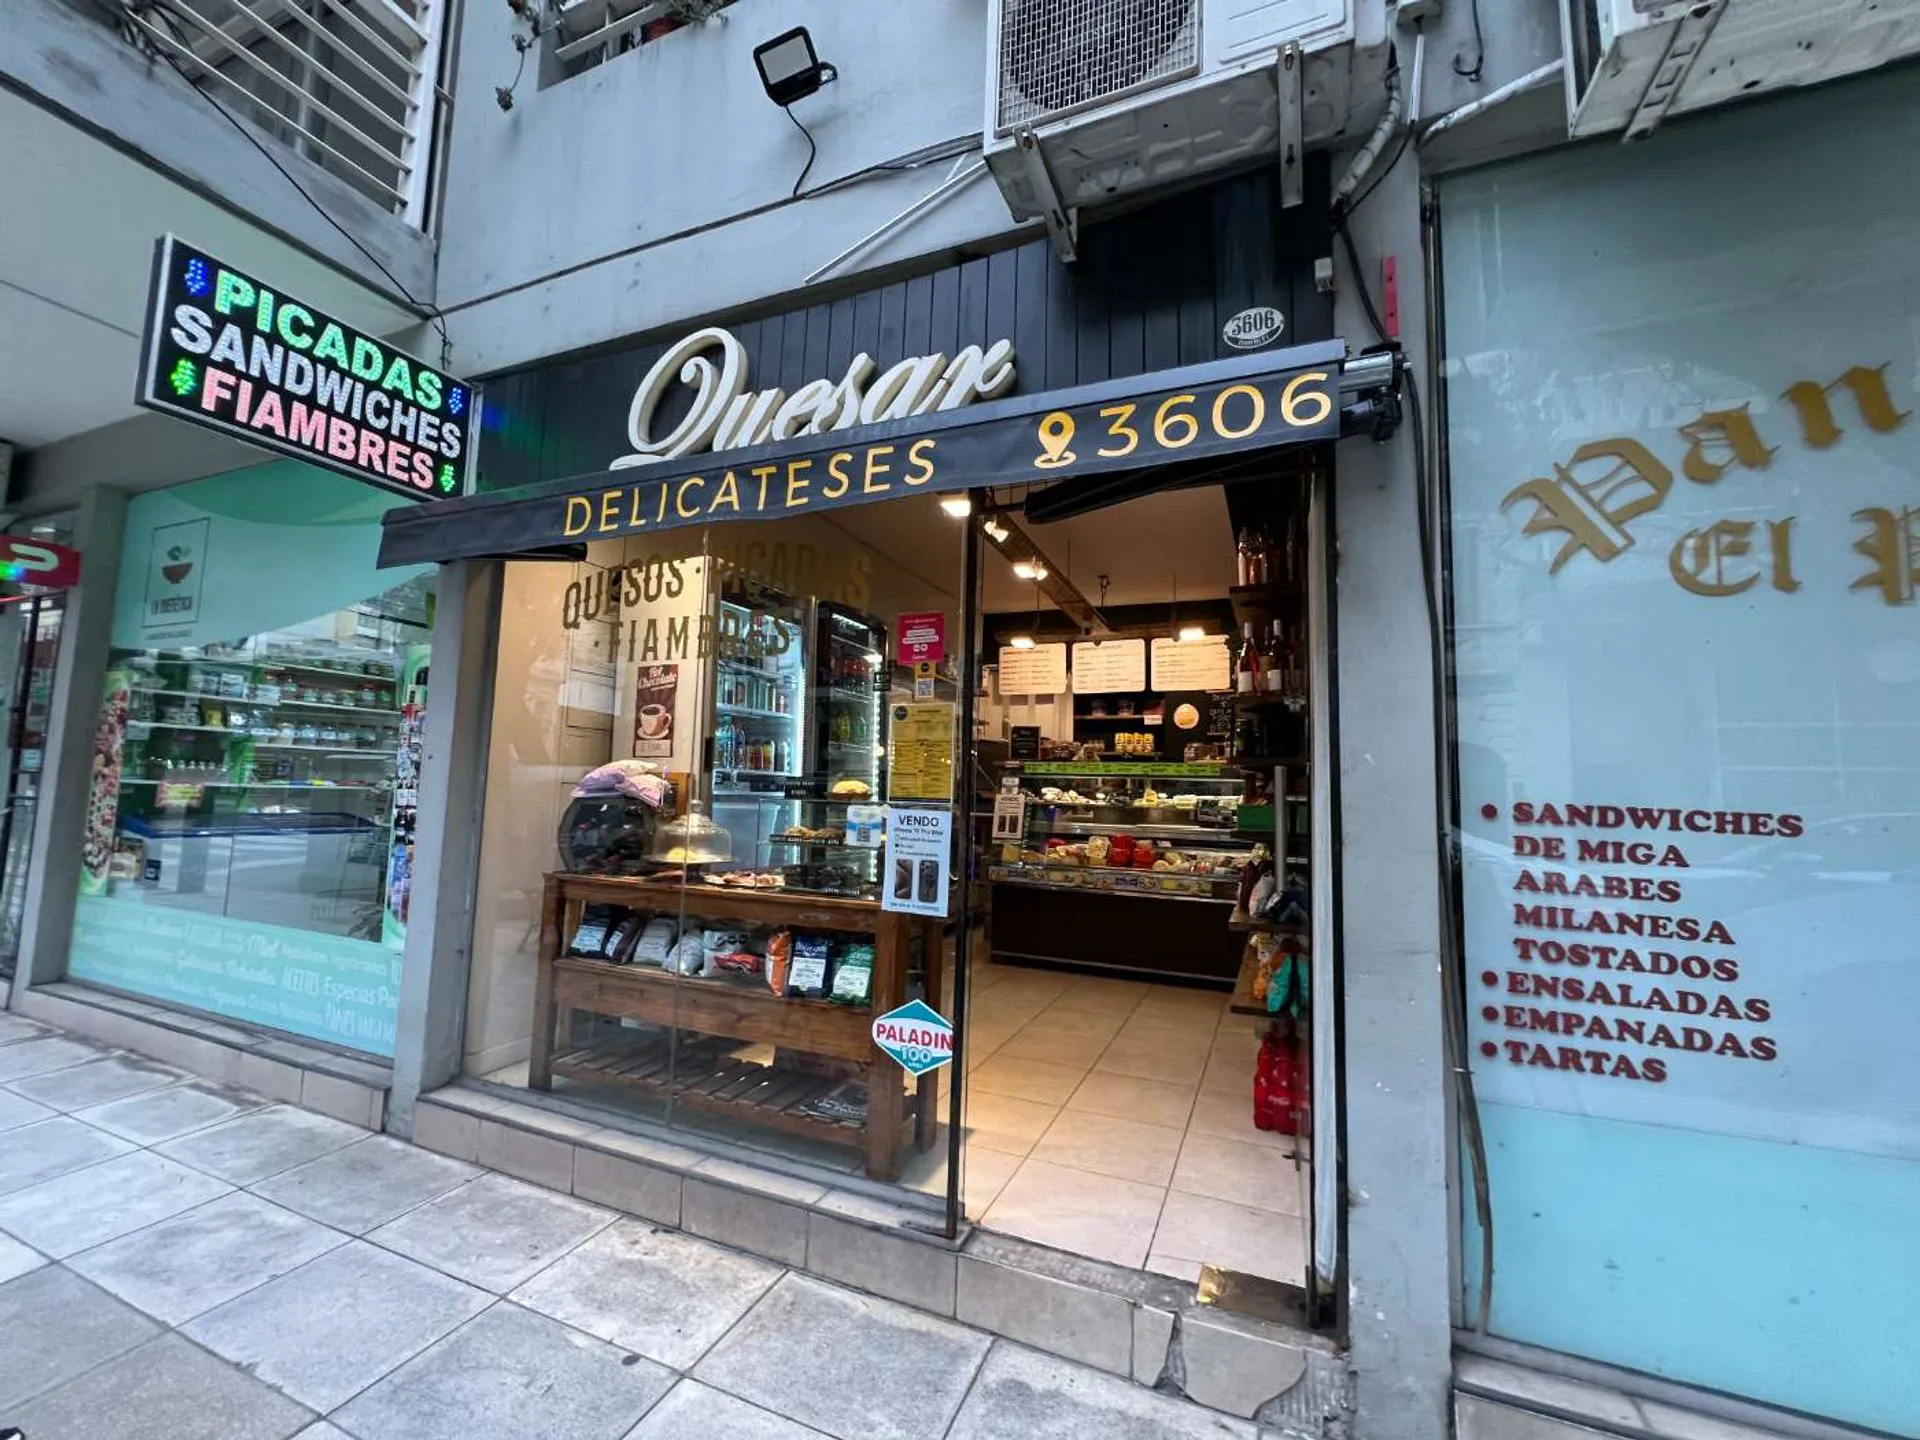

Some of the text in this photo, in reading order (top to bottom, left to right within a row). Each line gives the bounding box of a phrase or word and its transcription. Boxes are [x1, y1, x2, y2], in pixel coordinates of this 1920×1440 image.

[214, 269, 442, 410] PICADAS
[1231, 310, 1275, 335] 3606
[170, 304, 461, 458] SANDWICHES
[609, 327, 1018, 471] Quesar
[201, 366, 434, 490] FIAMBRES
[1097, 372, 1332, 458] 3606
[563, 439, 937, 537] DELICATESES
[1669, 516, 1802, 597] El
[562, 555, 685, 630] QUESOS
[608, 608, 790, 664] FIAMBRES
[899, 815, 939, 827] VENDO
[1512, 802, 1804, 838] SANDWICHES
[1513, 835, 1690, 868] DE MIGA
[1513, 870, 1682, 903] ARABES
[1513, 903, 1736, 945] MILANESA
[1513, 937, 1739, 982] TOSTADOS
[1507, 971, 1771, 1023] ENSALADAS
[876, 1023, 956, 1052] PALADIN
[1504, 1005, 1778, 1061] EMPANADAS
[1504, 1040, 1667, 1083] TARTAS
